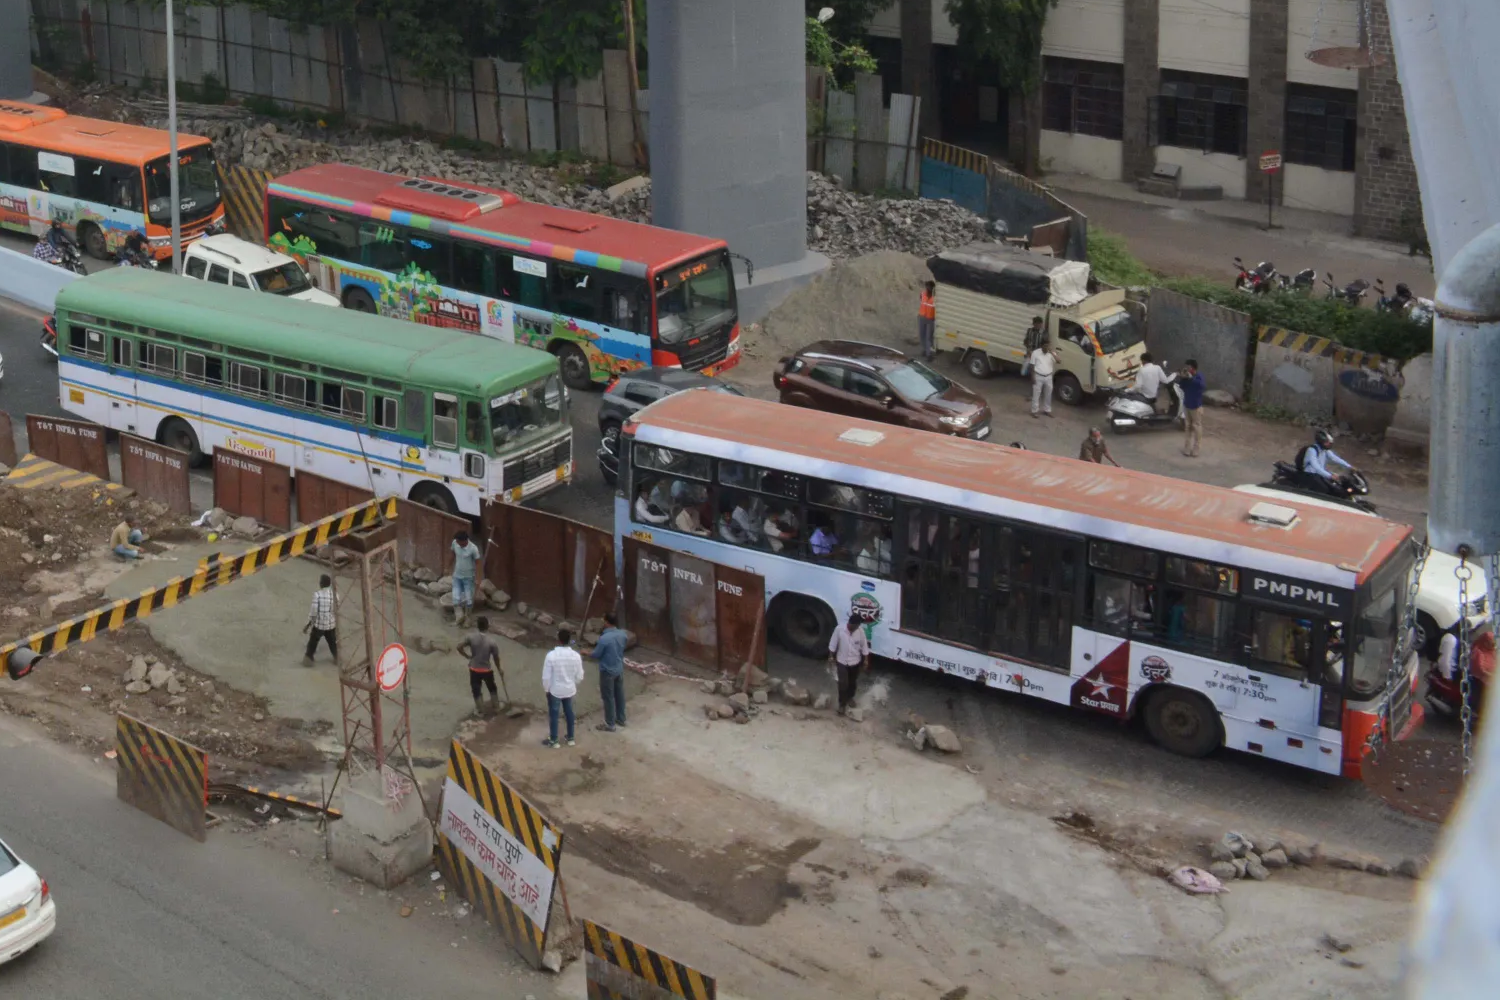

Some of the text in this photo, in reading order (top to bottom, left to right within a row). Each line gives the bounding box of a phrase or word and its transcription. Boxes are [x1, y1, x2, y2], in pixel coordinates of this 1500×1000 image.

[55, 424, 77, 436] INFRA
[79, 428, 97, 439] PUNE
[145, 450, 164, 463] INFRA
[165, 455, 182, 470] PUNE
[641, 558, 743, 597] T&T INFRA PUNE
[1253, 577, 1340, 608] PMPML
[896, 647, 902, 656] 7
[1213, 670, 1219, 678] 7
[1080, 696, 1100, 707] Star
[477, 839, 496, 869] काम
[504, 838, 523, 864] पुणे
